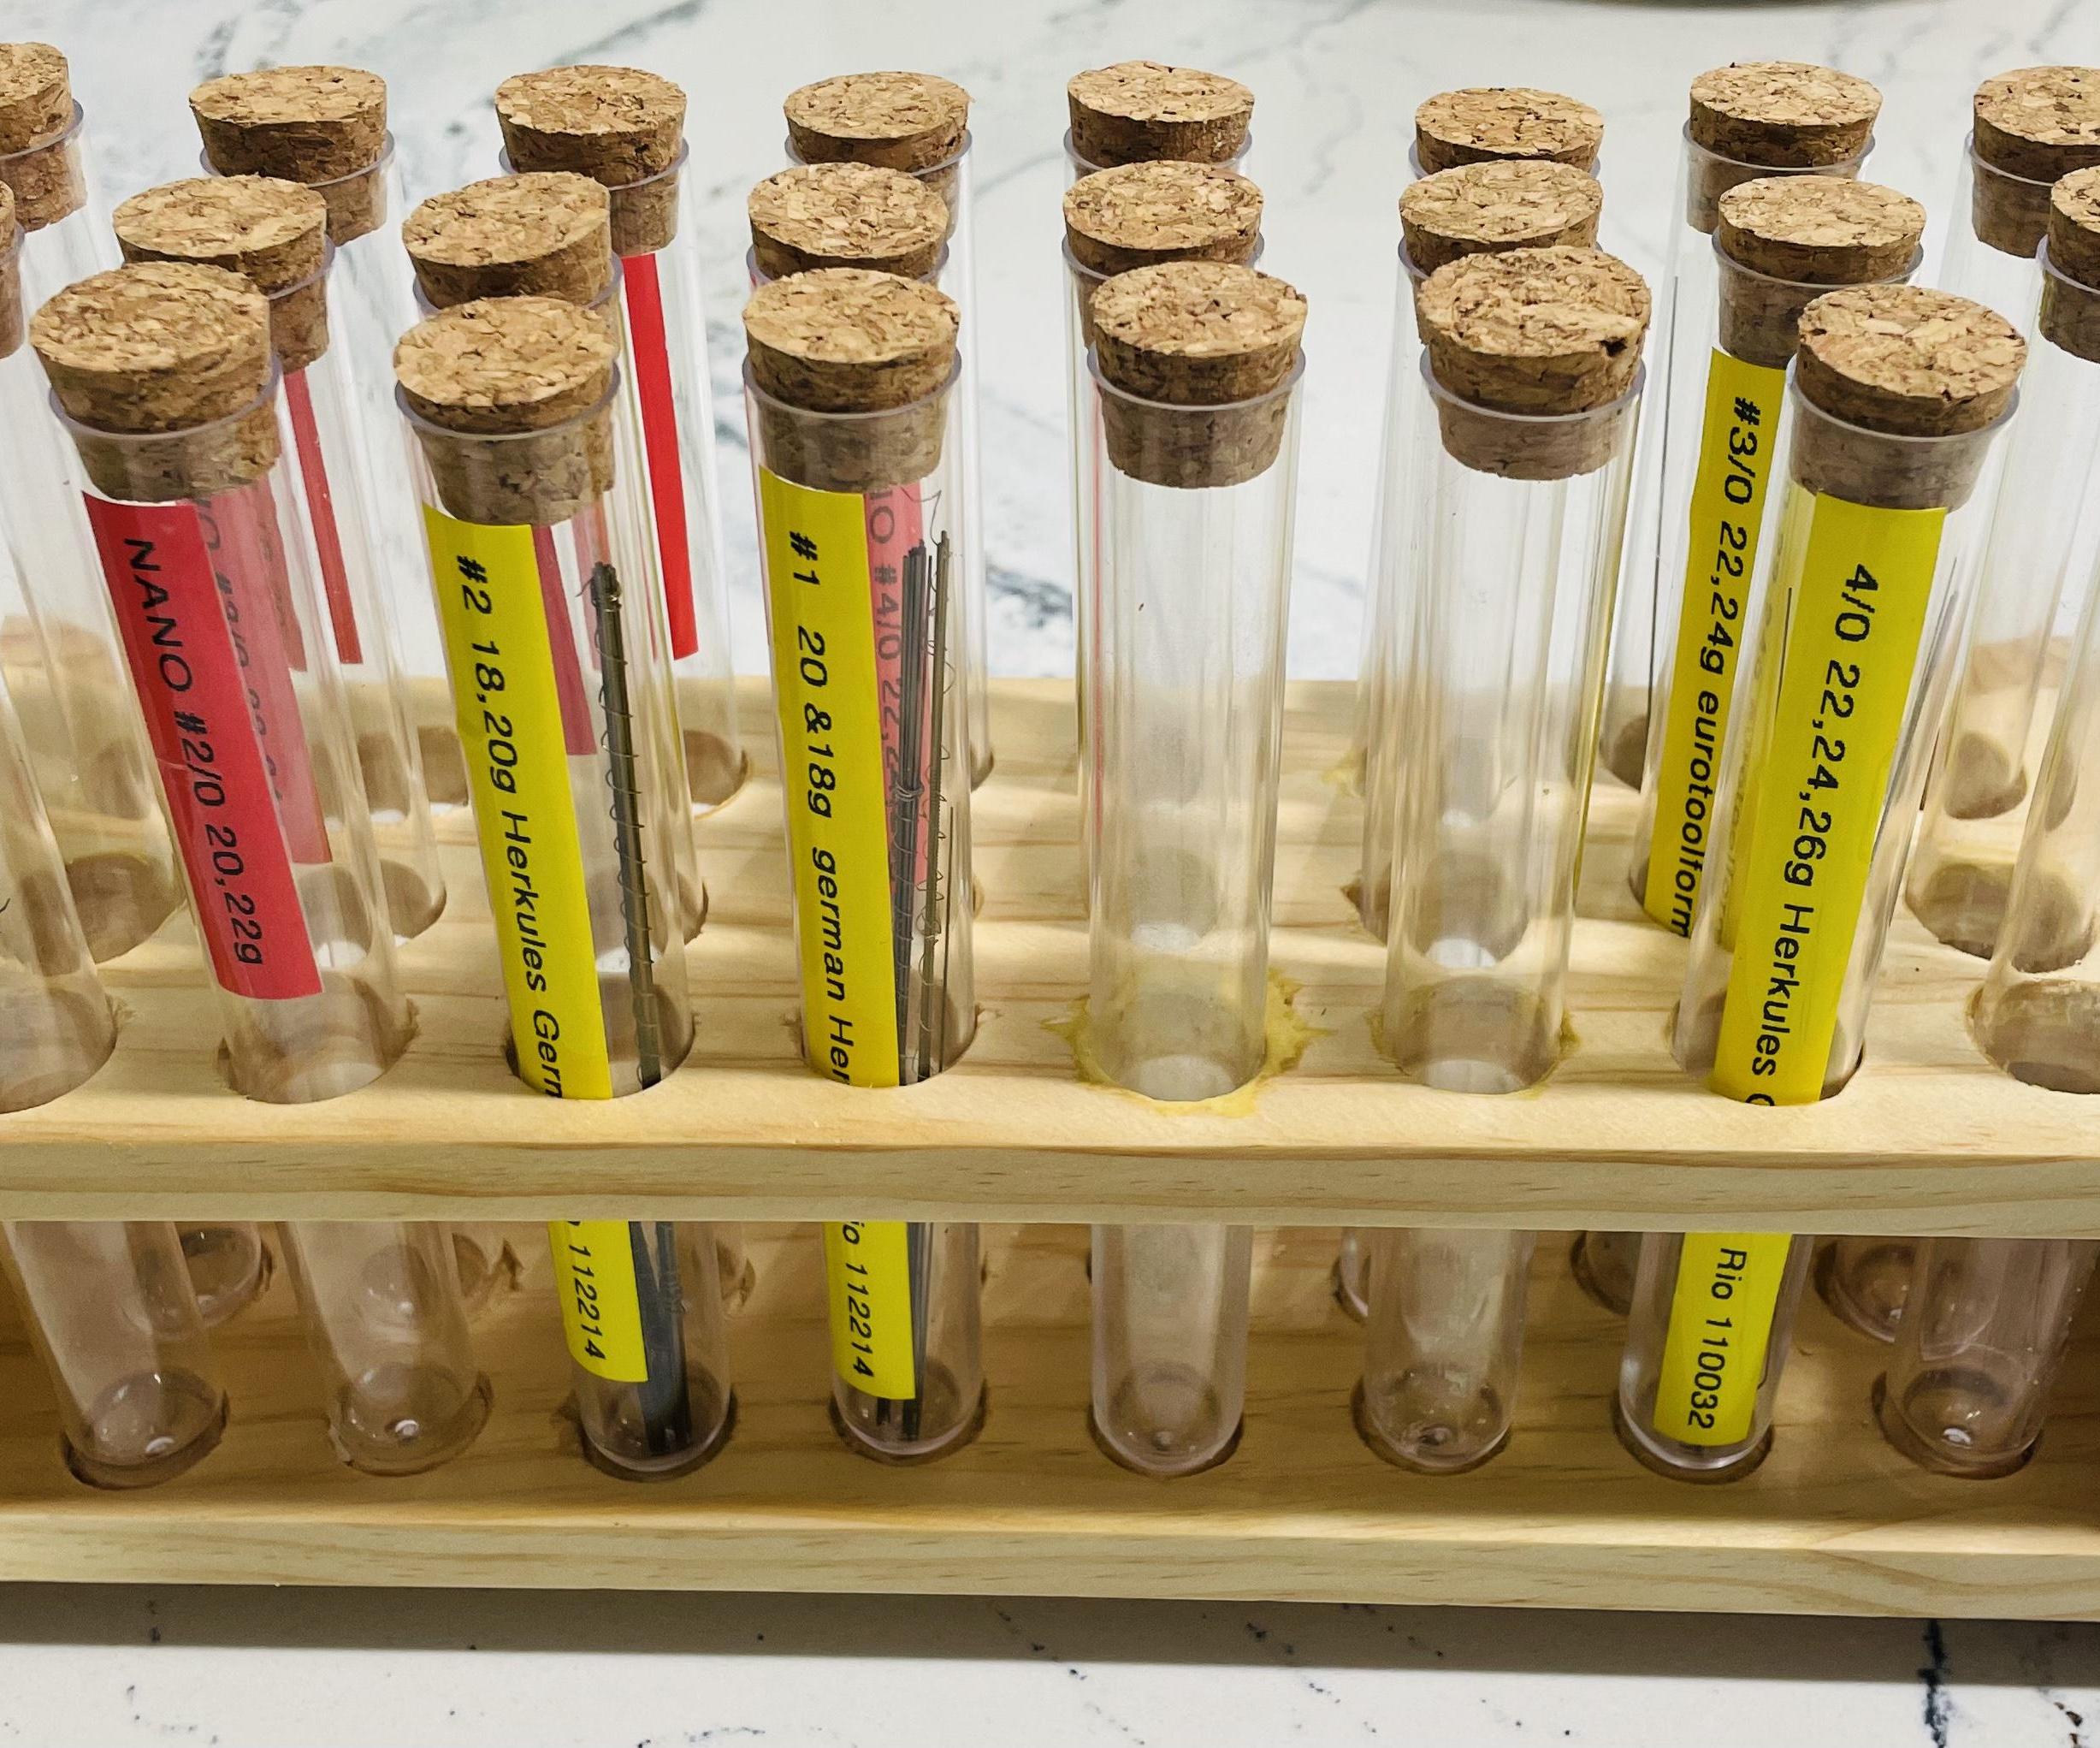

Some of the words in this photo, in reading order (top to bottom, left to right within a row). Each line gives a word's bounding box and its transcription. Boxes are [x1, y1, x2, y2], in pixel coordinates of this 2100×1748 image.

[1724, 396, 1760, 506] #3/0
[456, 554, 494, 614] #2
[788, 530, 819, 585] #1
[1699, 520, 1747, 675] 22,24g
[1834, 563, 1880, 643] 4/0
[796, 625, 829, 688] 20
[124, 537, 192, 693] NANO
[174, 710, 225, 808] #2/0
[205, 825, 263, 966] 20,22g
[470, 640, 518, 793] 18,20g
[802, 702, 837, 819] &18g
[1784, 660, 1860, 887] 22,24,26g
[1670, 690, 1719, 939] eurotoolform
[501, 810, 547, 993] Herkules
[812, 846, 846, 1001] german
[1751, 904, 1814, 1078] Herkules
[568, 1243, 606, 1360] 112214
[845, 1261, 875, 1378] 112214
[1709, 1247, 1748, 1301] Rio
[1686, 1315, 1733, 1431] 110032
